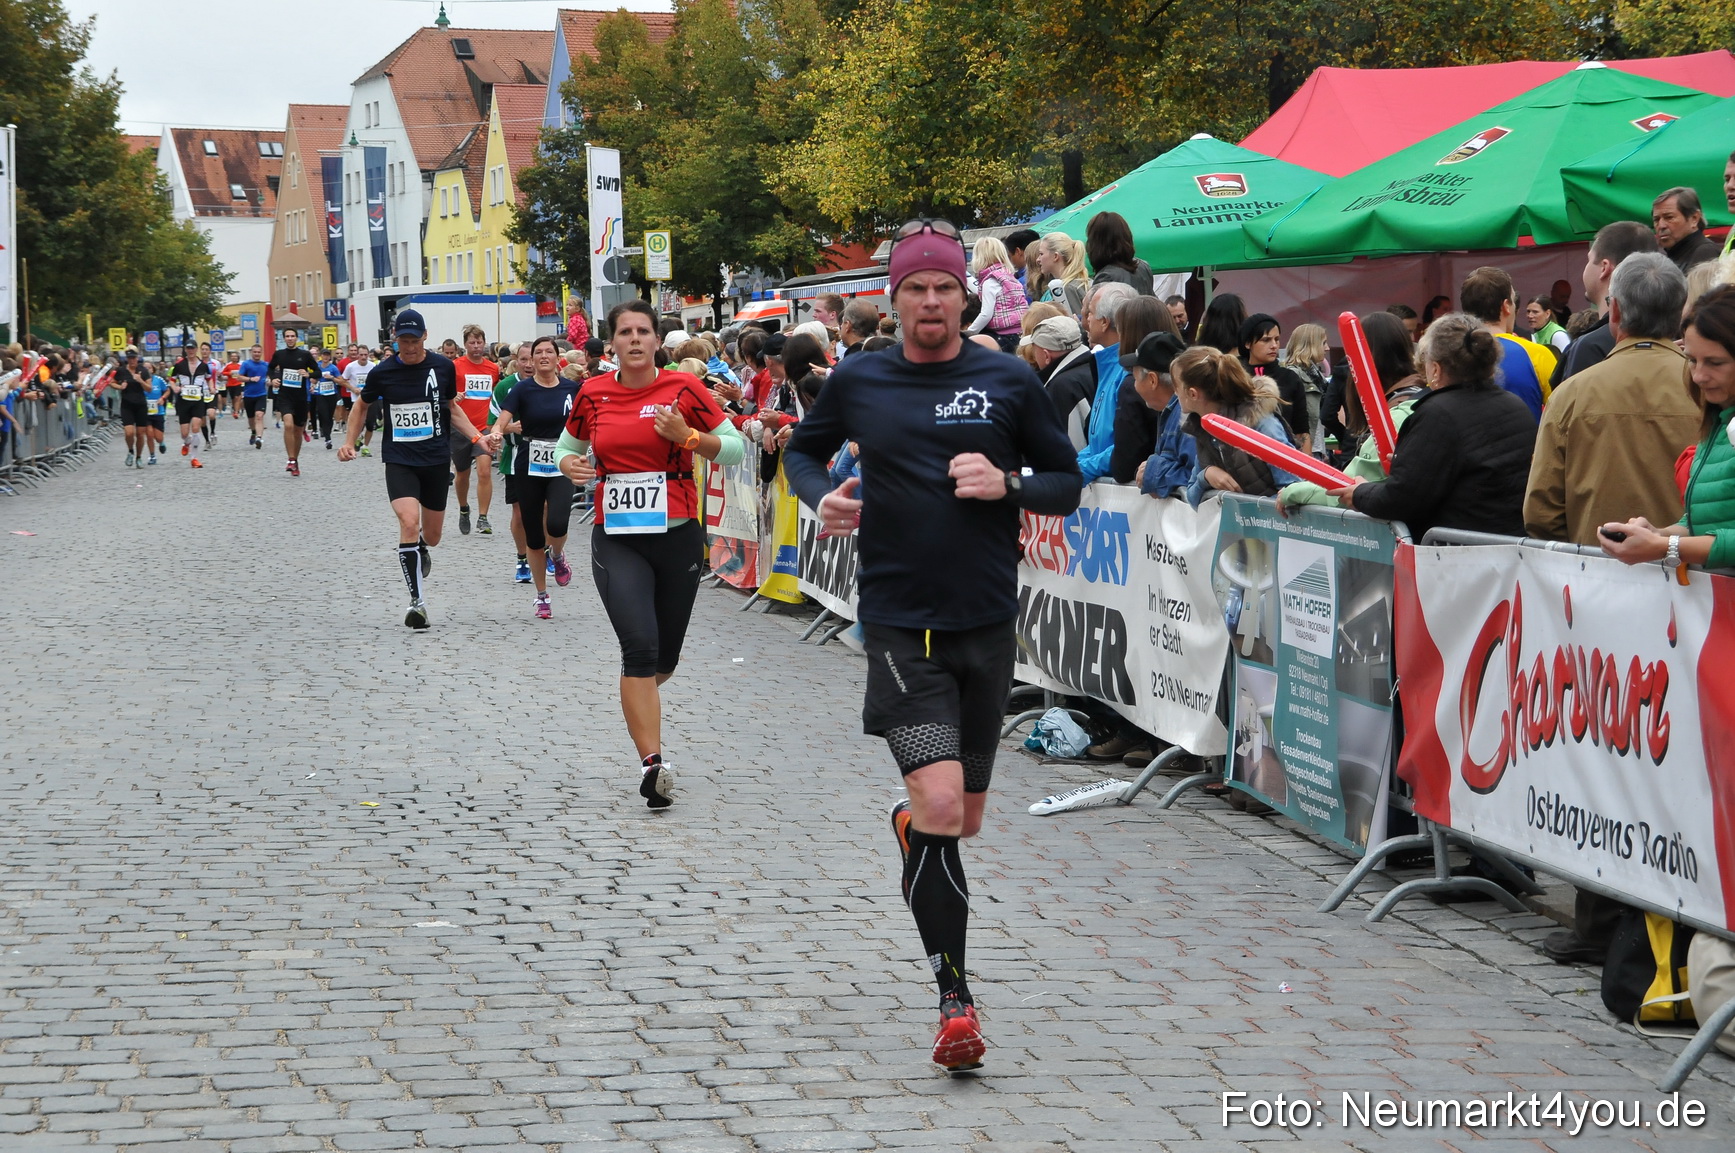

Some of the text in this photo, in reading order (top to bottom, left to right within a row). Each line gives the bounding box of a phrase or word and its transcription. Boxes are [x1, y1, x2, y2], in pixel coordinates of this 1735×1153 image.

[1172, 200, 1287, 216] Neumarkte
[1341, 186, 1466, 213] Lammsbräu
[114, 335, 122, 346] D
[327, 334, 335, 345] D
[468, 380, 490, 390] 3417
[395, 411, 428, 427] 2584
[935, 403, 971, 418] Spitz
[608, 486, 660, 511] 3407
[1158, 588, 1191, 623] Herzen
[1304, 597, 1332, 619] HOFFER
[1162, 622, 1184, 656] Stadt
[884, 650, 908, 693] SALOMON
[1459, 579, 1677, 796] Charivari
[1295, 727, 1322, 749] Trockenbau
[1280, 740, 1334, 774] Fassadenverkleidungen
[1306, 784, 1341, 810] Sanierungen
[1526, 784, 1699, 884] Ostbayerns Radio
